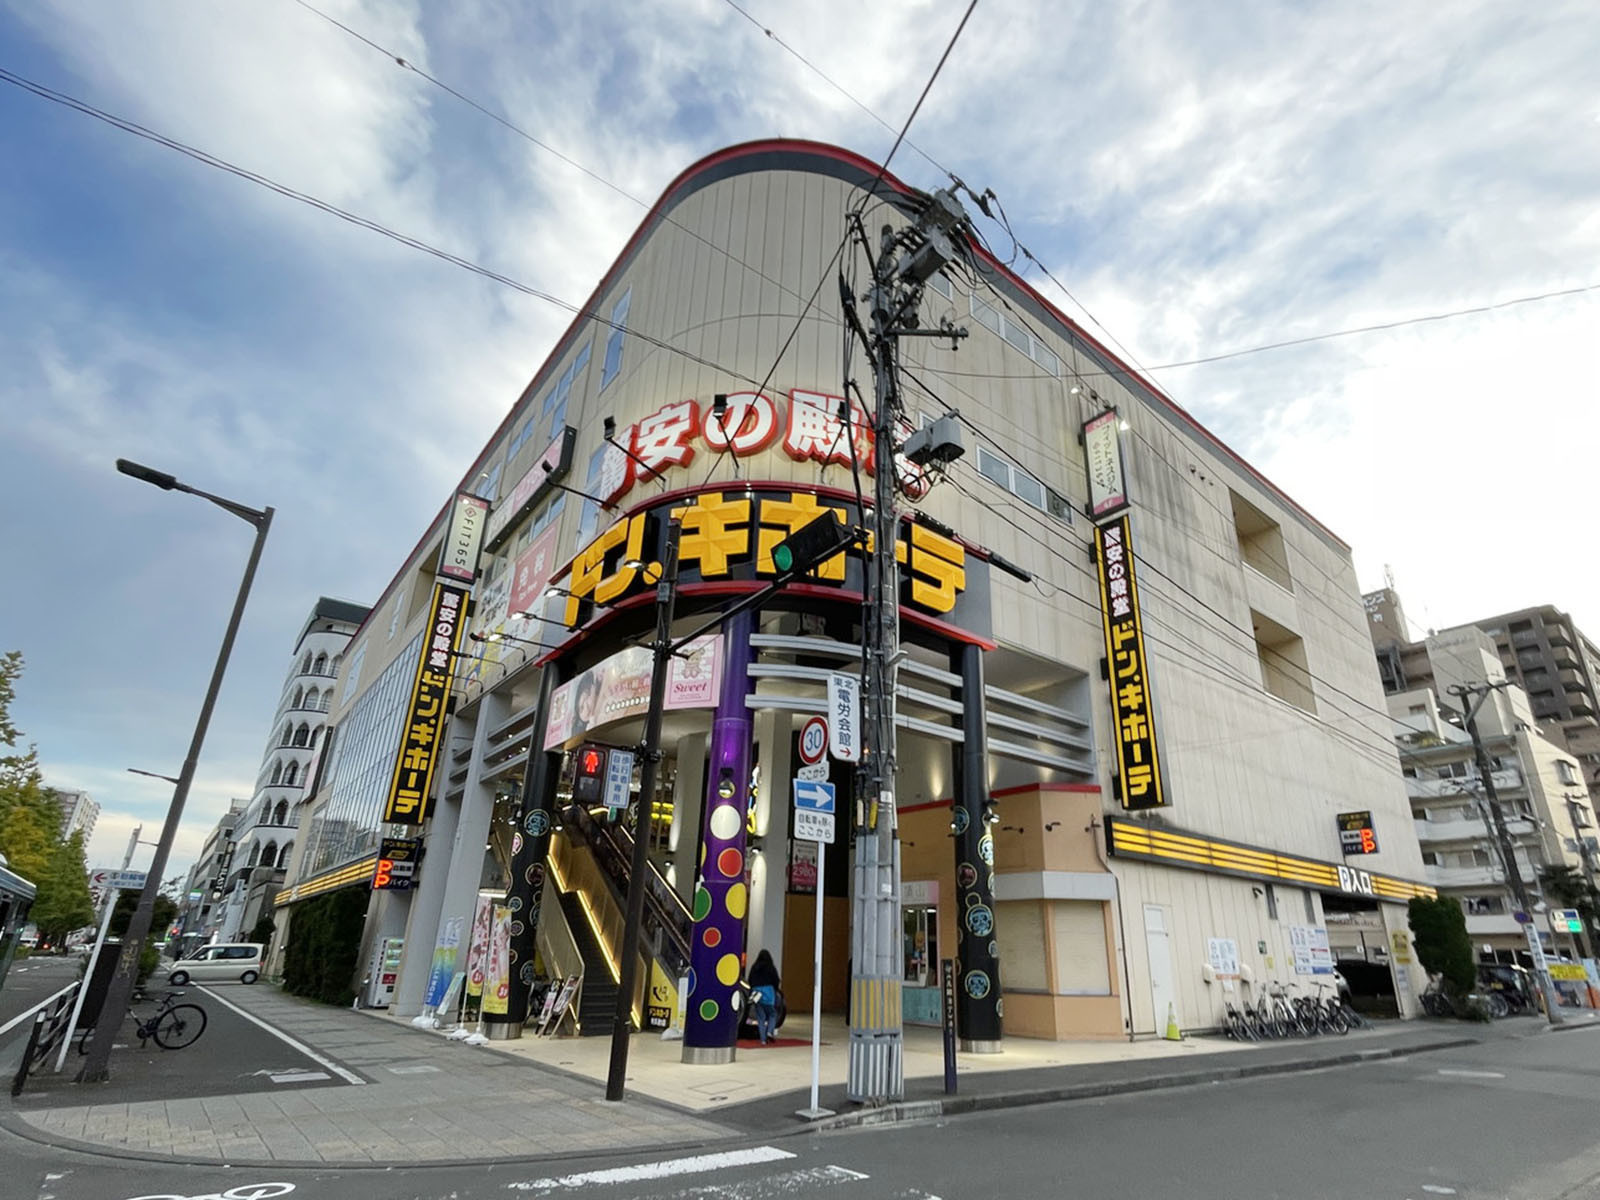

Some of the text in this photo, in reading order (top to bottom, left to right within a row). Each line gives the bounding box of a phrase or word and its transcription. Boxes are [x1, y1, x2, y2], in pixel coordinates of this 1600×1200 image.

[455, 518, 475, 567] FIT365
[673, 682, 707, 694] Sweet
[833, 676, 854, 690] 東北
[837, 689, 851, 747] 電労会館
[805, 728, 822, 751] 30
[798, 824, 832, 839] ここから
[1350, 868, 1373, 895] 入口
